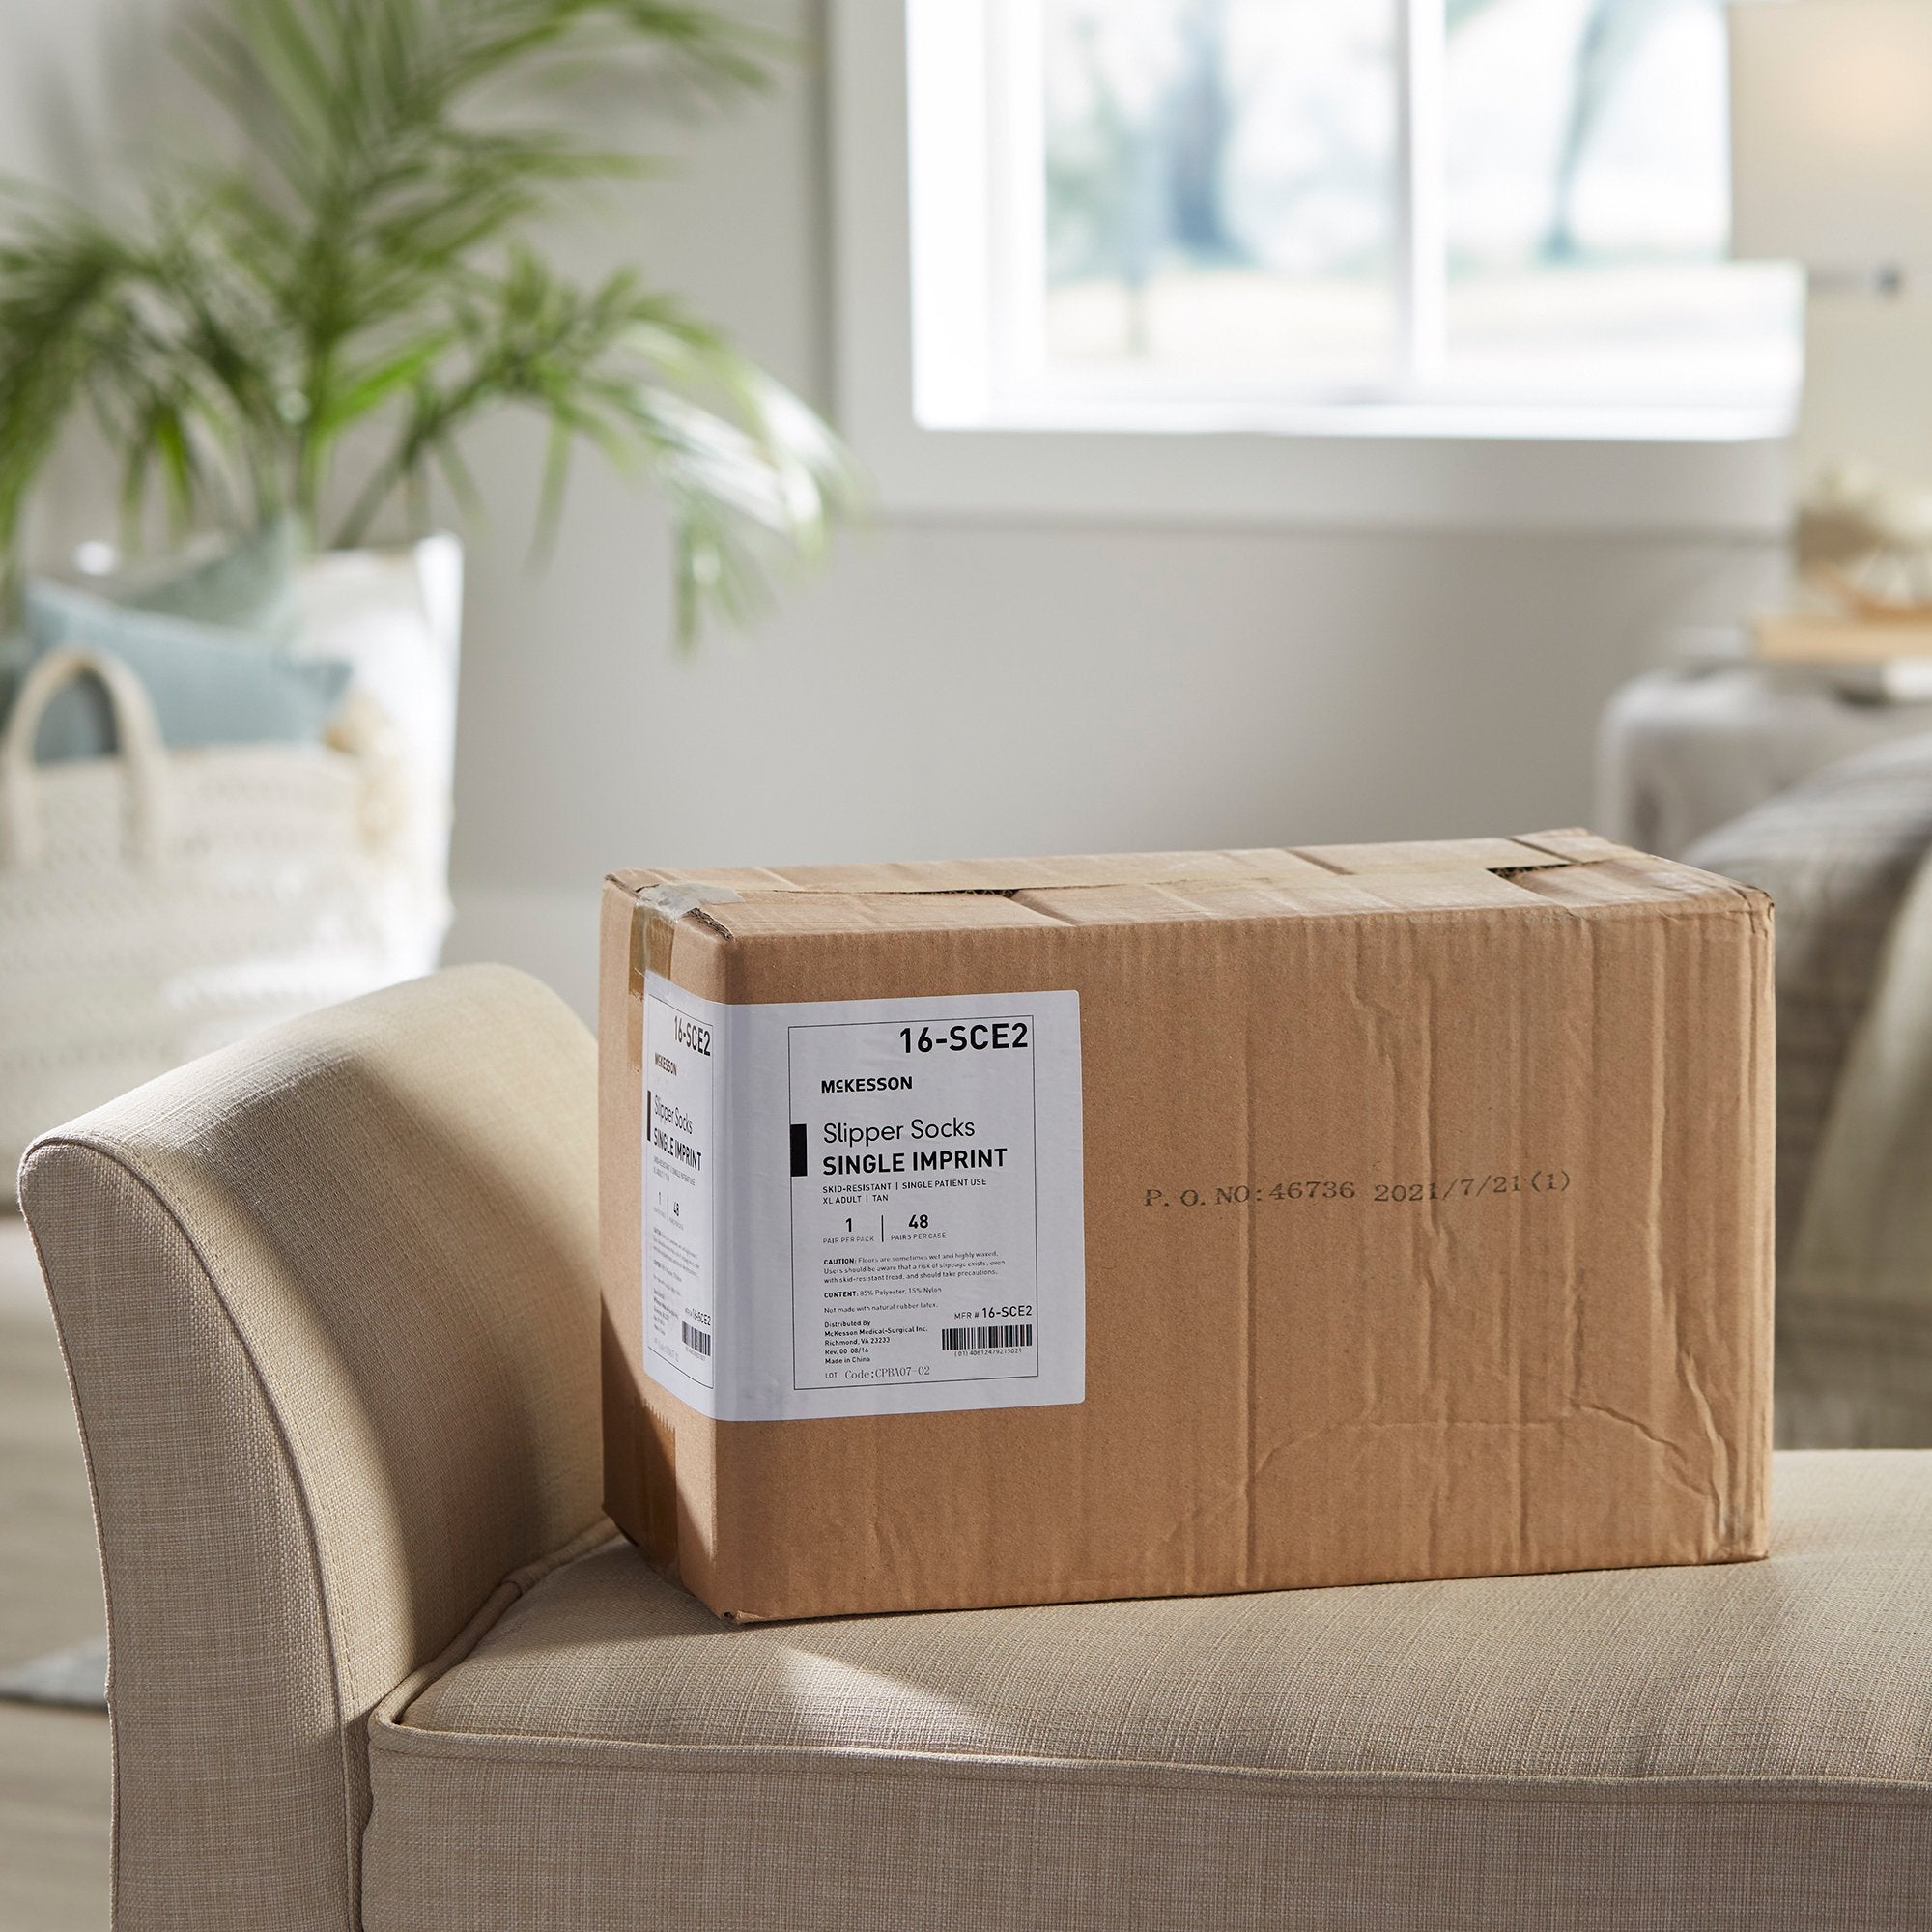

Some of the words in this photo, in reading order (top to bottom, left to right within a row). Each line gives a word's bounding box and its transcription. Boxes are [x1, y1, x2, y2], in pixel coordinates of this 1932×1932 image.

[674, 1016, 711, 1056] 16-SCE2
[900, 1023, 1028, 1053] 16-SCE2
[654, 1094, 674, 1125] Slipper
[675, 1108, 693, 1135] Socks
[824, 1123, 903, 1147] Slipper
[911, 1118, 975, 1139] Socks
[654, 1128, 673, 1157] SINGLE
[674, 1139, 701, 1171] IMPRINT
[823, 1153, 905, 1176] SINGLE
[913, 1149, 1007, 1171] IMPRINT
[823, 1183, 891, 1194] SKID-RESISTANT
[902, 1180, 932, 1190] SINGLE
[935, 1179, 968, 1188] PATIENT
[658, 1192, 662, 1205] 1
[836, 1195, 861, 1204] ADULT
[673, 1202, 680, 1217] 48
[845, 1218, 852, 1232] 1
[909, 1214, 928, 1229] 48
[838, 1274, 885, 1283] skid-resistant
[958, 1268, 998, 1277] precautions.
[981, 1306, 1033, 1318] 16-SCE2
[860, 1326, 914, 1335] Medical-Surgical
